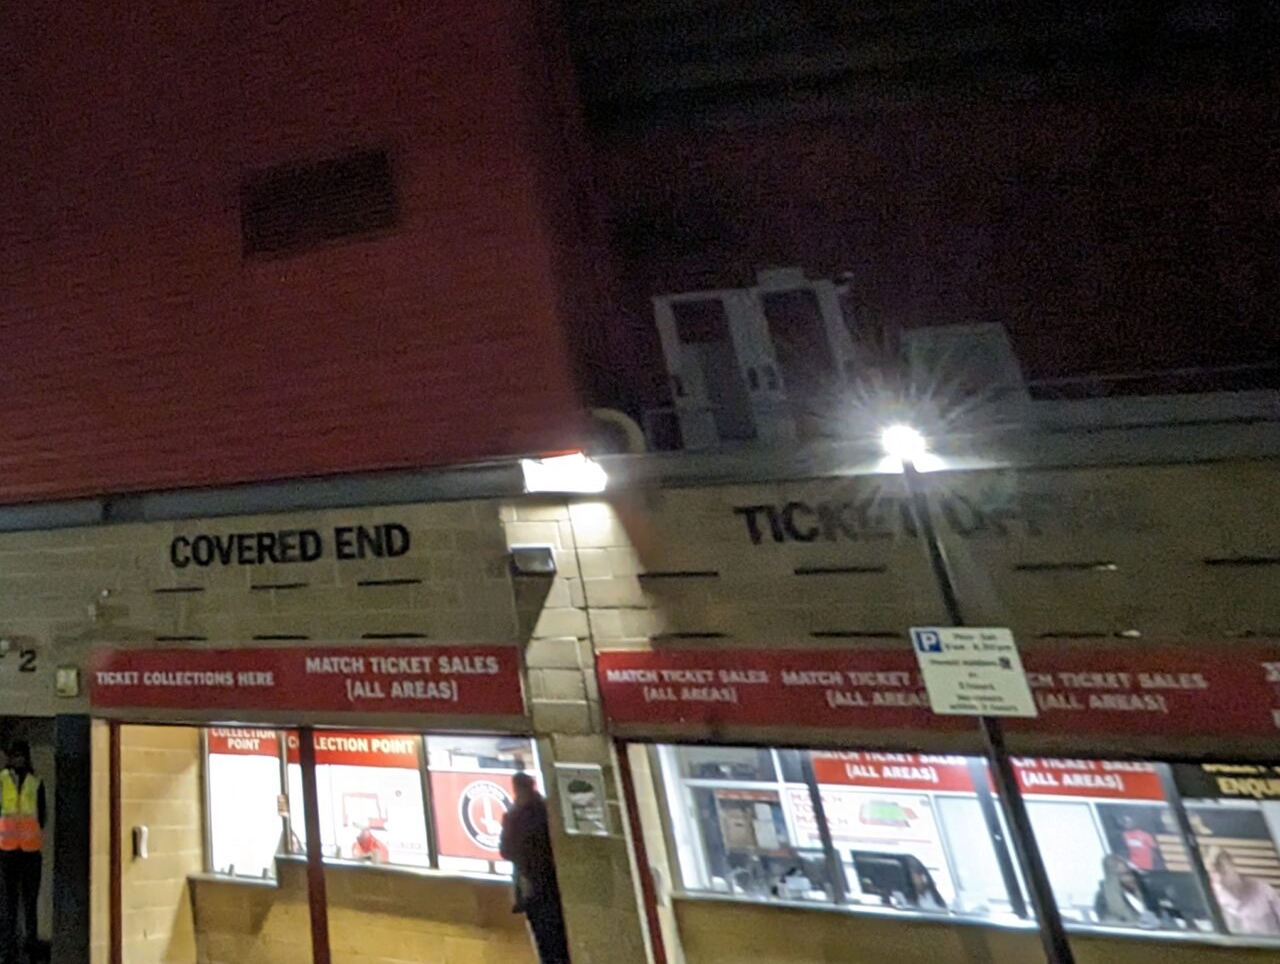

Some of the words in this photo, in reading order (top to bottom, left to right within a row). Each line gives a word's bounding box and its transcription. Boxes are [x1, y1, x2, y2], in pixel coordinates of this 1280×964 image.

[170, 529, 322, 568] COVERED
[334, 523, 411, 560] END
[18, 648, 37, 673] 2
[305, 656, 364, 674] MATCH
[370, 656, 431, 674] TICKET
[438, 656, 499, 674] SALES
[96, 671, 139, 685] TICKET
[143, 671, 234, 686] COLLECTIONS
[237, 671, 275, 686] HERE
[606, 669, 659, 683] MATCH
[660, 669, 714, 683] TICKET
[718, 670, 769, 683] SALES
[780, 669, 843, 686] MATCH
[847, 670, 910, 686] TICKET
[1058, 672, 1131, 688] TICKET
[1137, 673, 1209, 689] SALES
[345, 678, 385, 702] (ALL
[391, 679, 459, 702] AREAS)
[643, 686, 677, 702] (ALL
[825, 689, 869, 708] (ALL
[211, 727, 276, 739] COLLECTION
[227, 739, 260, 750] POINT
[371, 738, 415, 754] POINT
[845, 762, 880, 780] (ALL
[883, 765, 939, 784] AREAS)
[1021, 769, 1059, 788] (ALL
[1062, 771, 1125, 792] AREAS)
